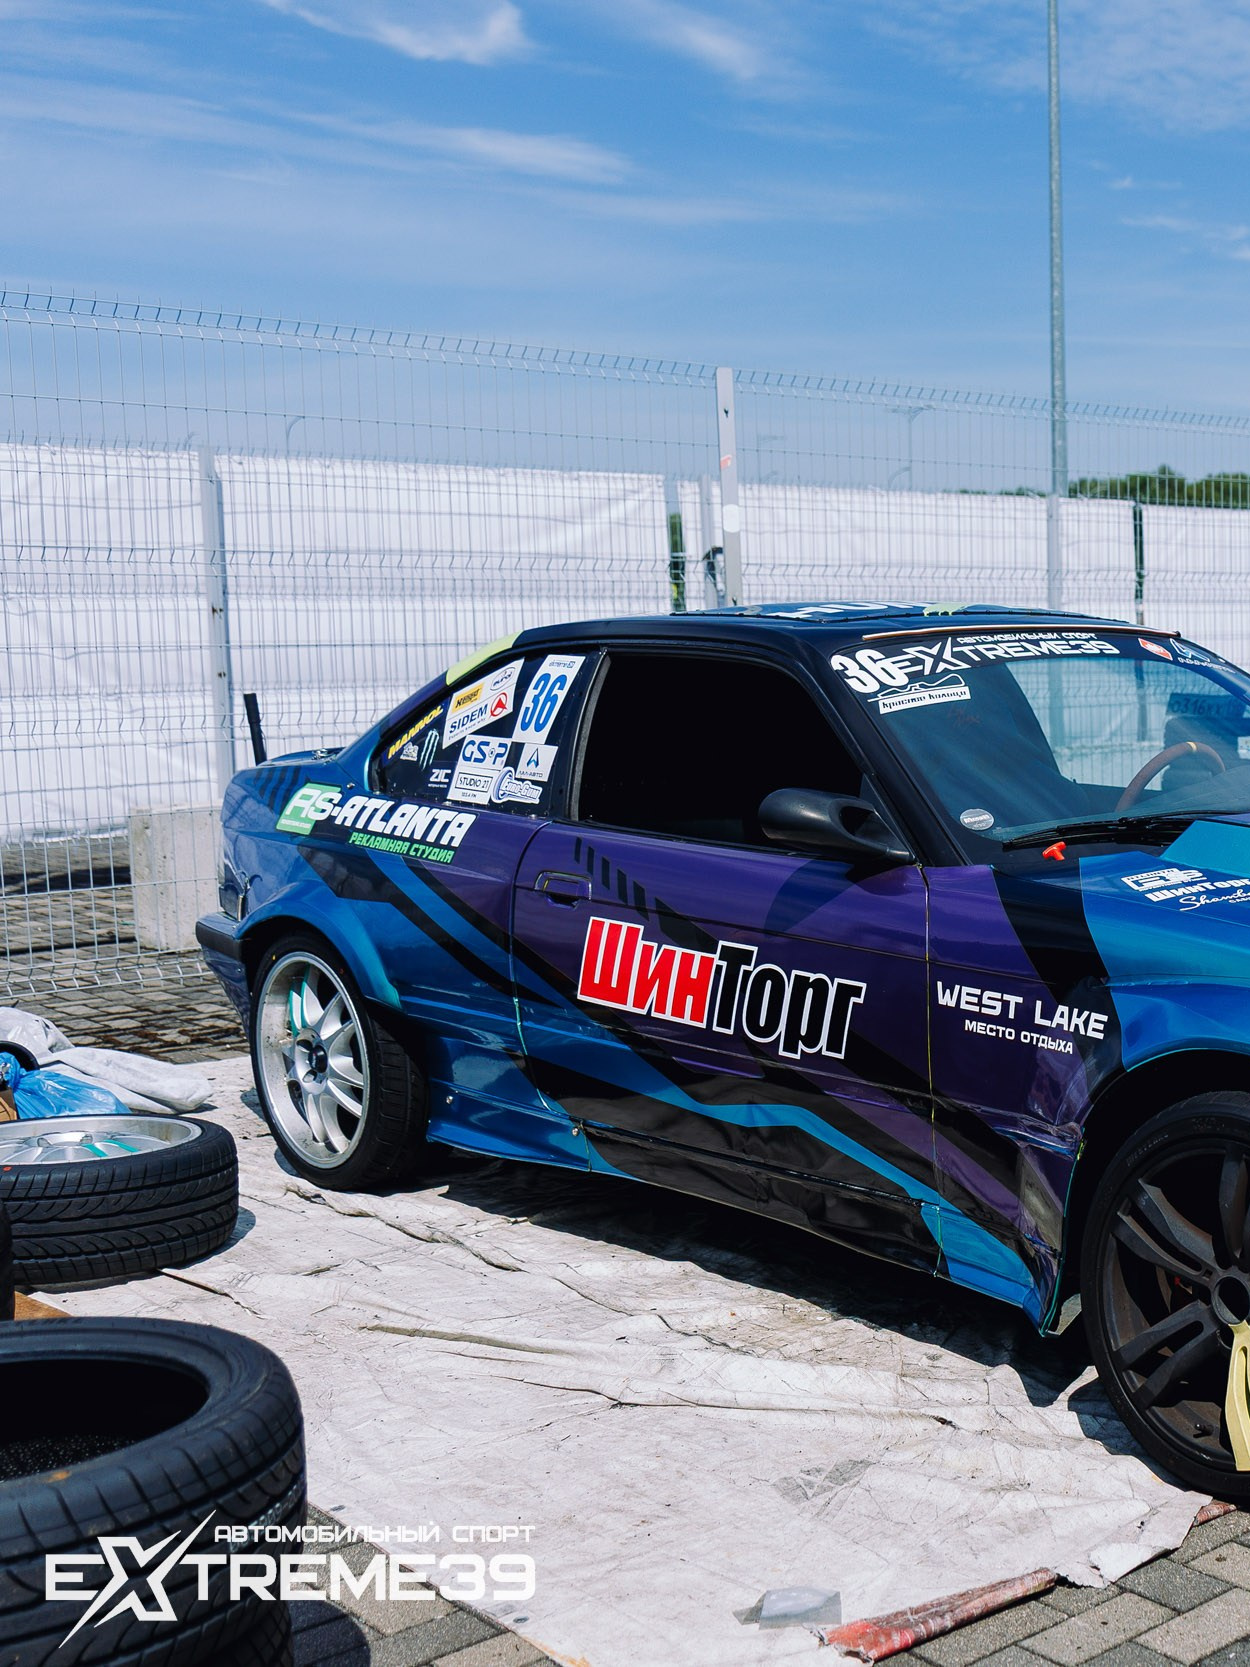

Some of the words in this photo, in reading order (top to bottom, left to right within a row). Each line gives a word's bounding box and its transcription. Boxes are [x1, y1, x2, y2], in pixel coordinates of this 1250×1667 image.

[1062, 632, 1097, 640] СПОРТ
[831, 648, 909, 694] 36
[449, 703, 489, 734] SIDEM
[520, 672, 567, 733] 36
[429, 769, 452, 783] ZIC
[459, 776, 482, 788] STUDIO
[349, 832, 409, 855] РЕКЛАМНАЯ
[410, 843, 455, 864] СТУДИЯ
[577, 916, 867, 1060] ШинТорг
[936, 981, 1023, 1020] WEST
[1034, 999, 1108, 1040] LAKE
[964, 1019, 1016, 1041] МЕСТО
[1020, 1031, 1073, 1055] ОТДЫХА
